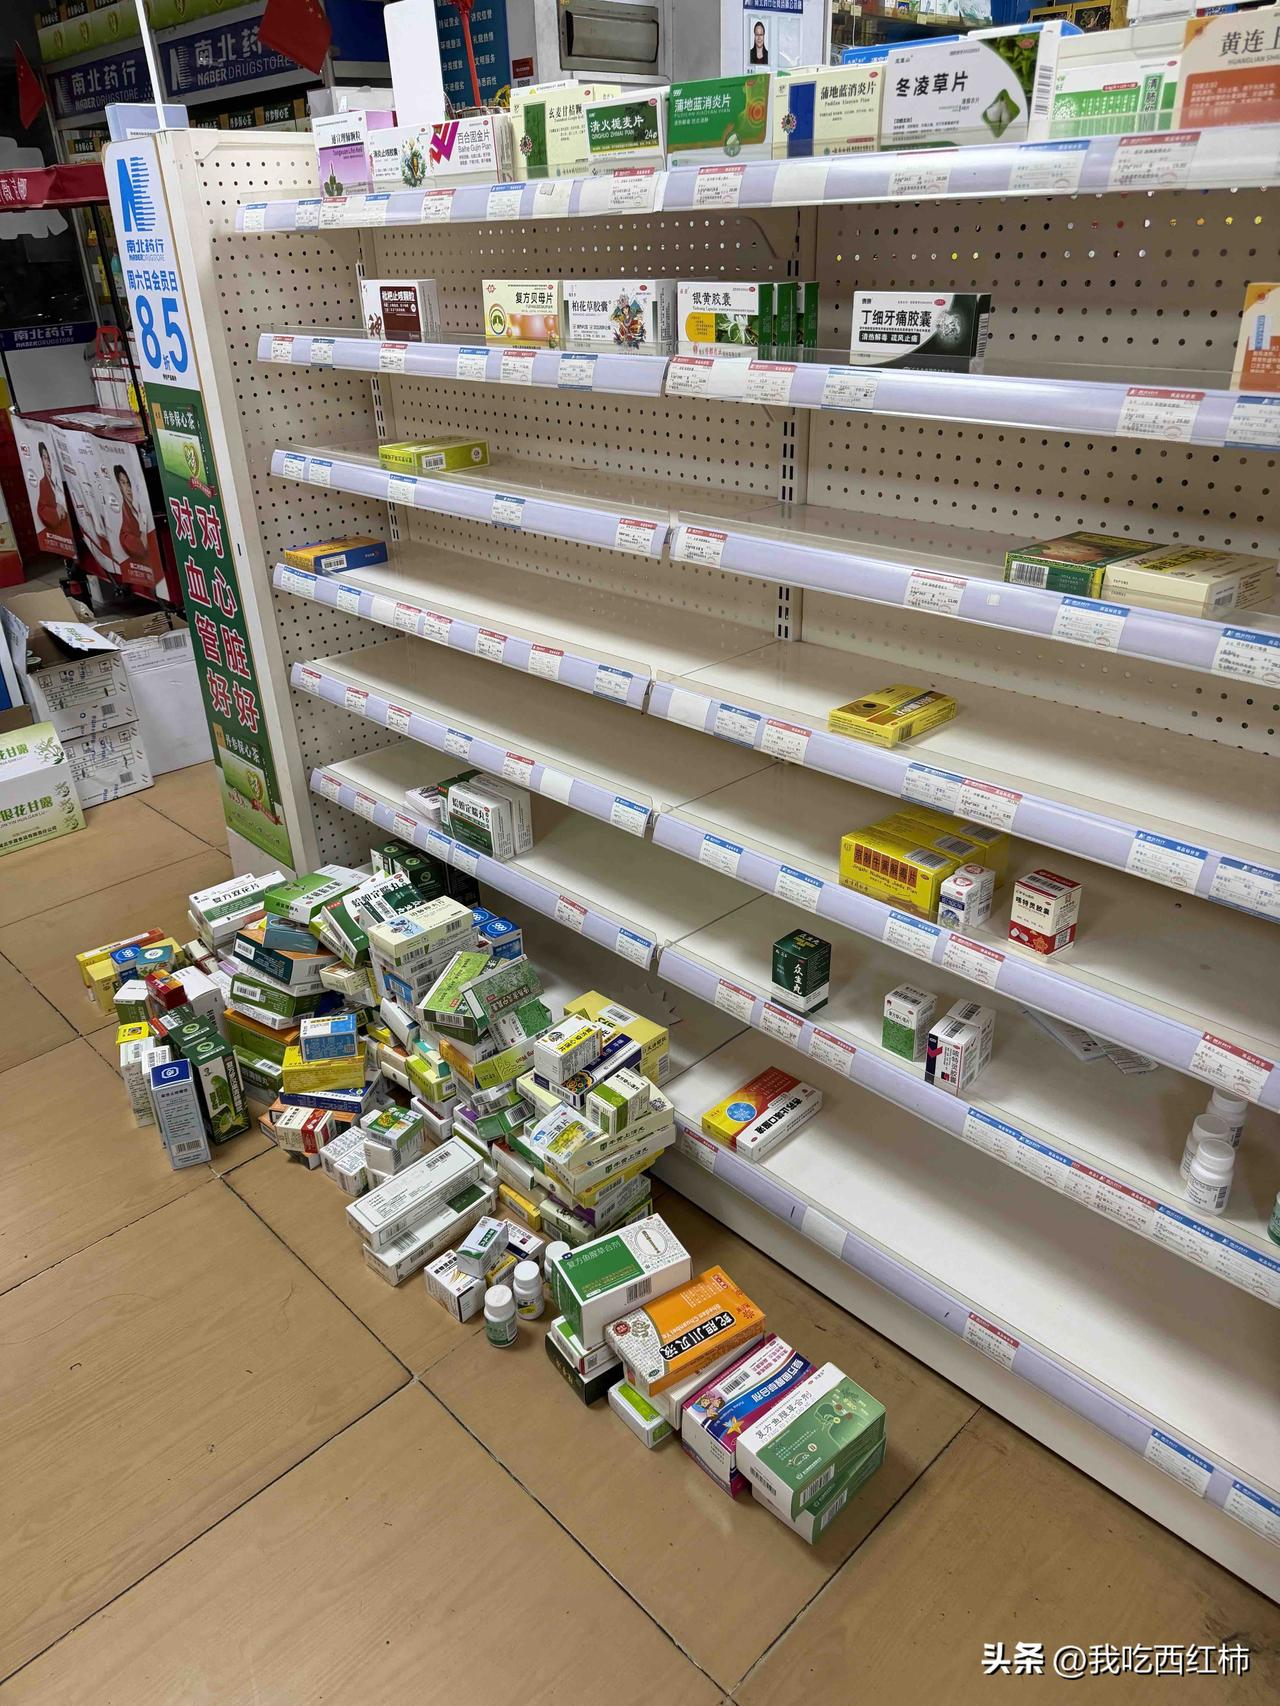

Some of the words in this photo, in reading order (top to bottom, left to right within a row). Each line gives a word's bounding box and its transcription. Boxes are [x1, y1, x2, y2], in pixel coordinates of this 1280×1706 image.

[71, 58, 138, 97] 南北药行
[896, 70, 969, 98] 冬凌草片
[821, 82, 877, 100] 蒲地蓝消炎片
[674, 94, 732, 113] 蒲地蓝消炎片
[590, 115, 645, 132] 清火栀麦片
[457, 130, 490, 145] 百合固金片
[126, 239, 165, 254] 南北药行
[127, 269, 178, 292] 周六日会员日
[515, 291, 554, 304] 复方贝母片
[571, 300, 609, 313] 柏花草胶囊
[692, 292, 732, 307] 银黄胶囊
[861, 309, 932, 328] 丁细牙痛胶囊
[13, 325, 74, 341] 南北药行
[862, 332, 888, 342] 清热解毒
[890, 333, 918, 343] 疏风止痛
[0, 795, 54, 822] 银花甘露
[854, 844, 918, 888] 京制牛黄解毒片
[793, 963, 804, 996] 众生丸
[754, 1097, 803, 1135] 杏苏止咳口服液
[566, 1239, 622, 1269] 复方鱼腥草合剂
[662, 1313, 733, 1359] 蛇胆川贝液
[751, 1357, 804, 1403] 复方鱼腥草合剂
[755, 1390, 813, 1440] 复方鱼腥草合剂
